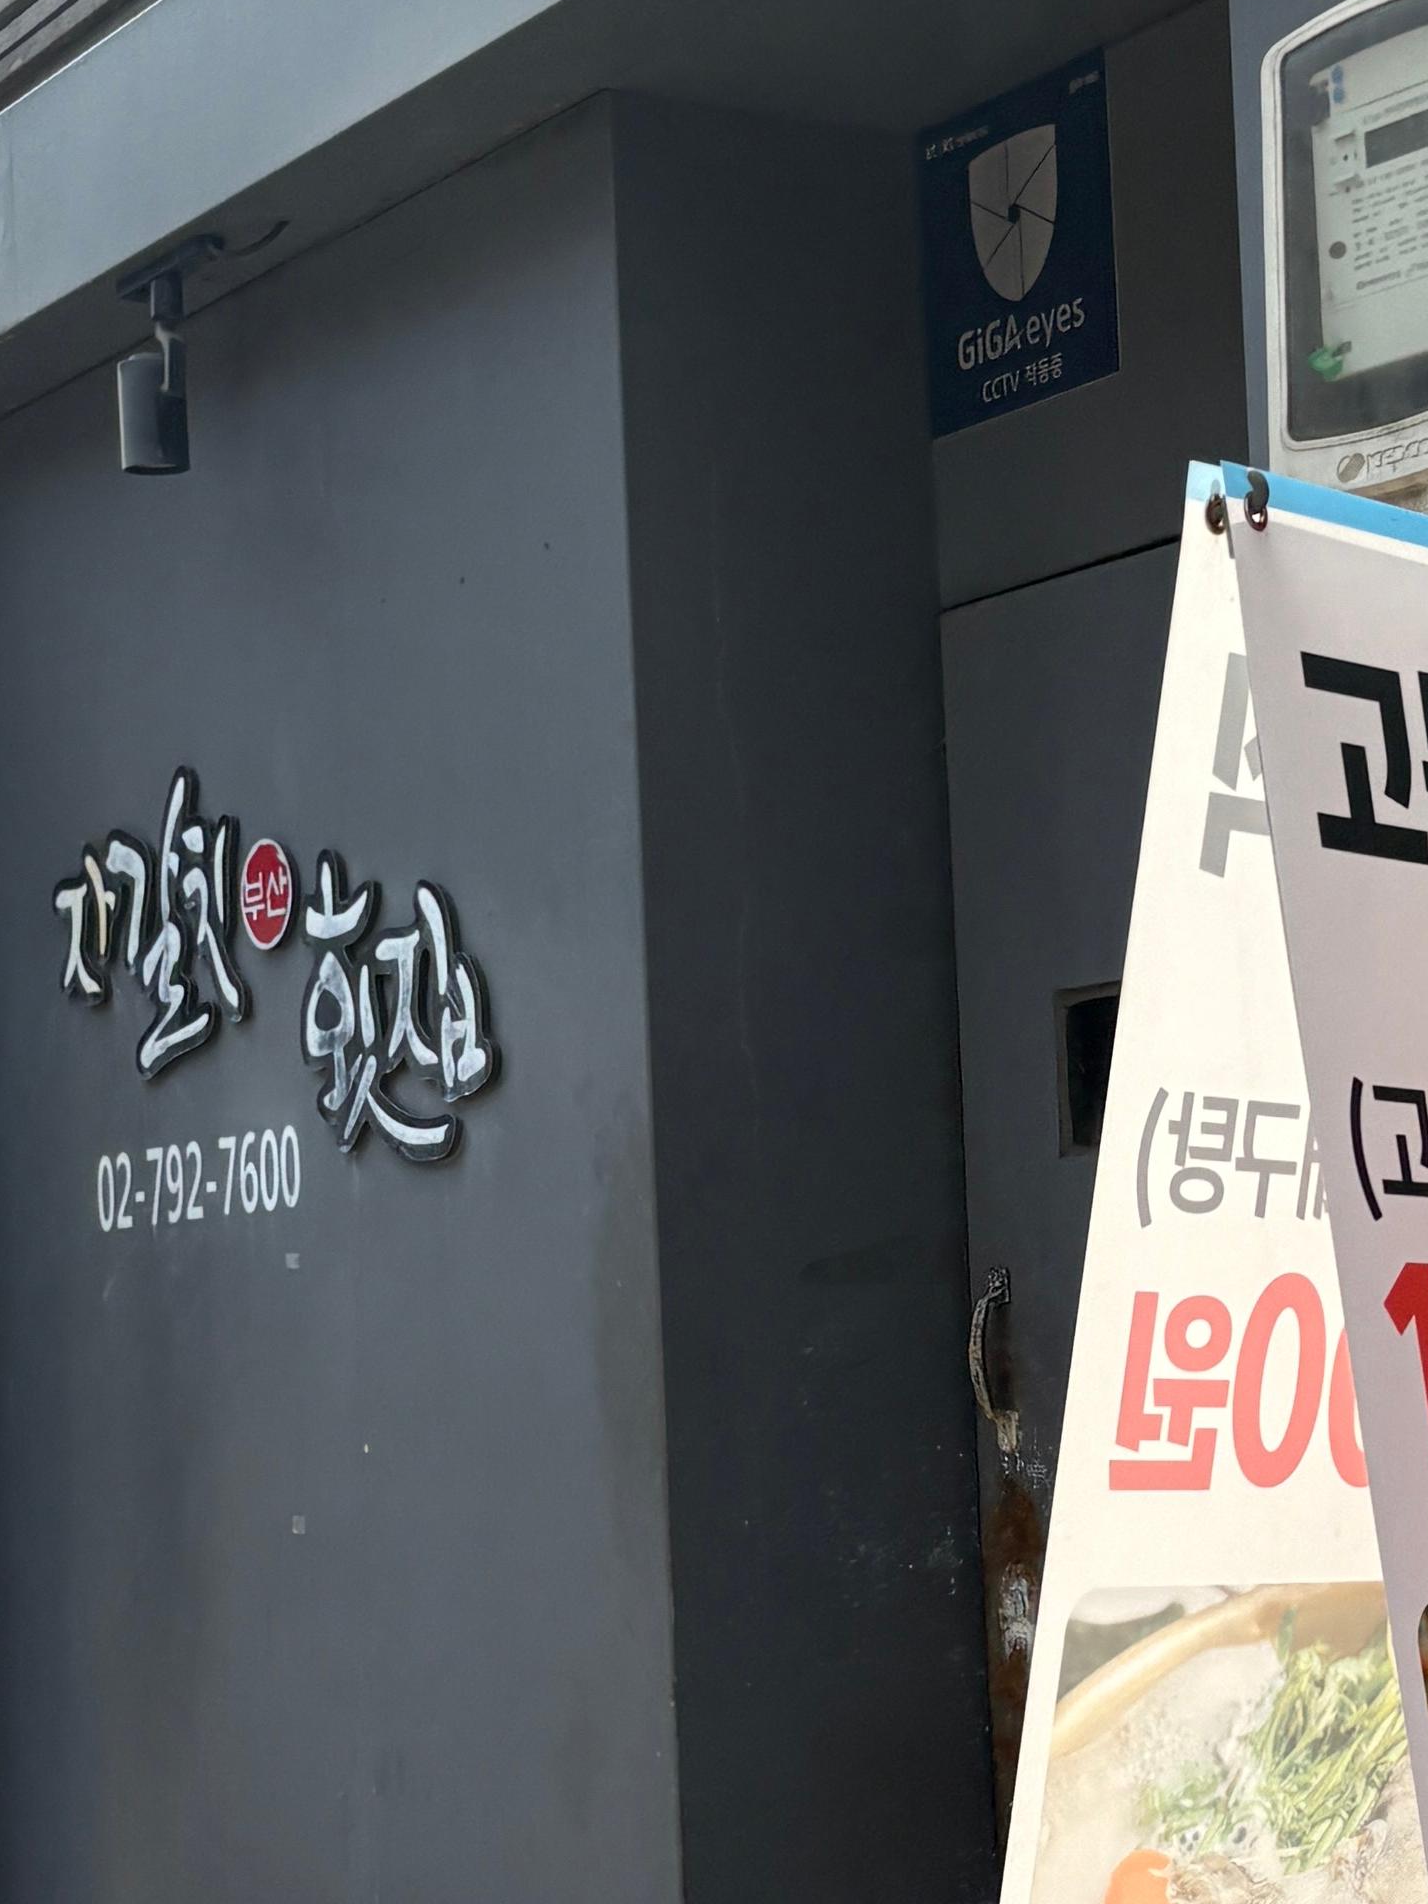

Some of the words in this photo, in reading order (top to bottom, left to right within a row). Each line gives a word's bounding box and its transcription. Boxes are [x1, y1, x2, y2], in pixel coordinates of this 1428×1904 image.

[982, 370, 1021, 403] CCTV
[1024, 352, 1064, 387] 작동중
[55, 769, 245, 1076] 자갈치
[243, 870, 289, 920] 부산
[303, 854, 490, 1154] 횟집
[97, 1125, 301, 1232] 02-792-7600
